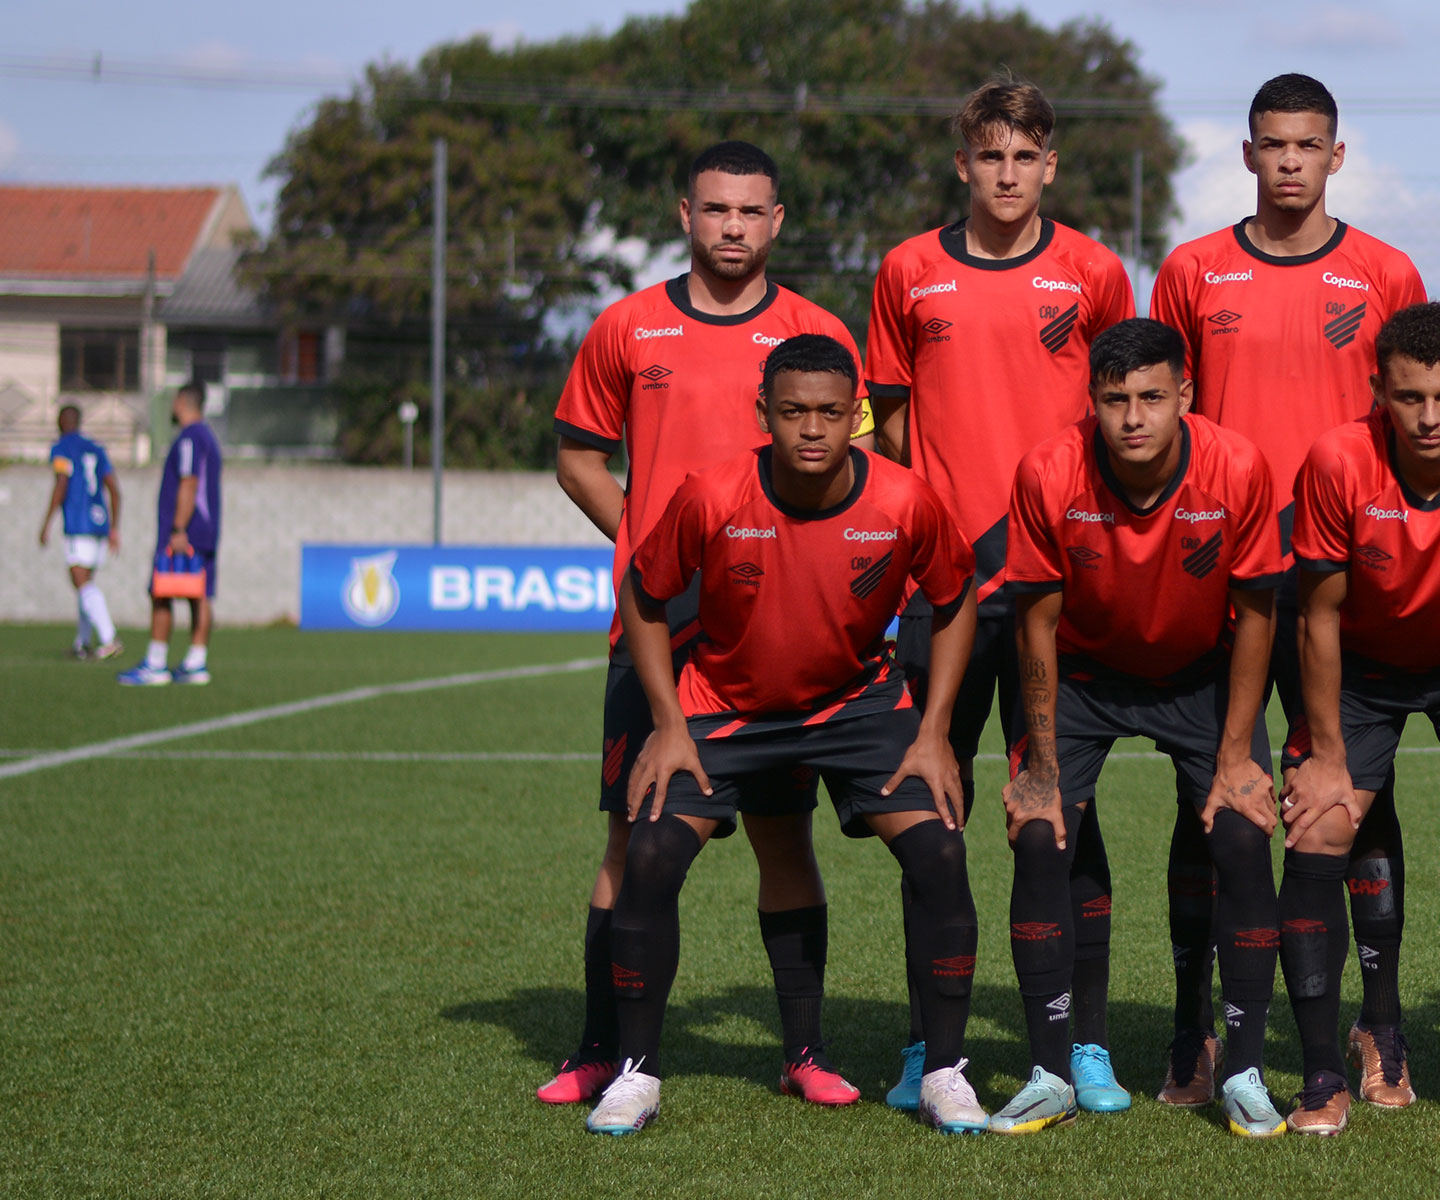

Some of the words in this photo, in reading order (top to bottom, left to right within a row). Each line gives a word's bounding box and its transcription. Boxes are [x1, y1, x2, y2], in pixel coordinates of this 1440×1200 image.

[1032, 276, 1082, 294] Copacol
[1205, 269, 1253, 285] Copacol
[910, 279, 957, 299] Copacol
[1039, 305, 1060, 319] CAP
[1326, 302, 1346, 316] CAP
[634, 325, 684, 340] Copacol
[752, 332, 786, 347] Copa
[927, 334, 951, 343] umbro
[1211, 327, 1240, 336] umbro
[641, 381, 670, 391] umbro
[1066, 508, 1116, 524] Copacol
[1174, 507, 1226, 524] Copacol
[1365, 503, 1408, 523] Copacol
[726, 525, 777, 541] Copacol
[843, 527, 898, 543] Copacol
[851, 555, 873, 571] CAP
[430, 565, 616, 612] BRASI
[1348, 878, 1389, 896] CAP
[933, 968, 976, 977] umbr
[613, 977, 645, 988] bro
[1049, 1012, 1070, 1022] umbr
